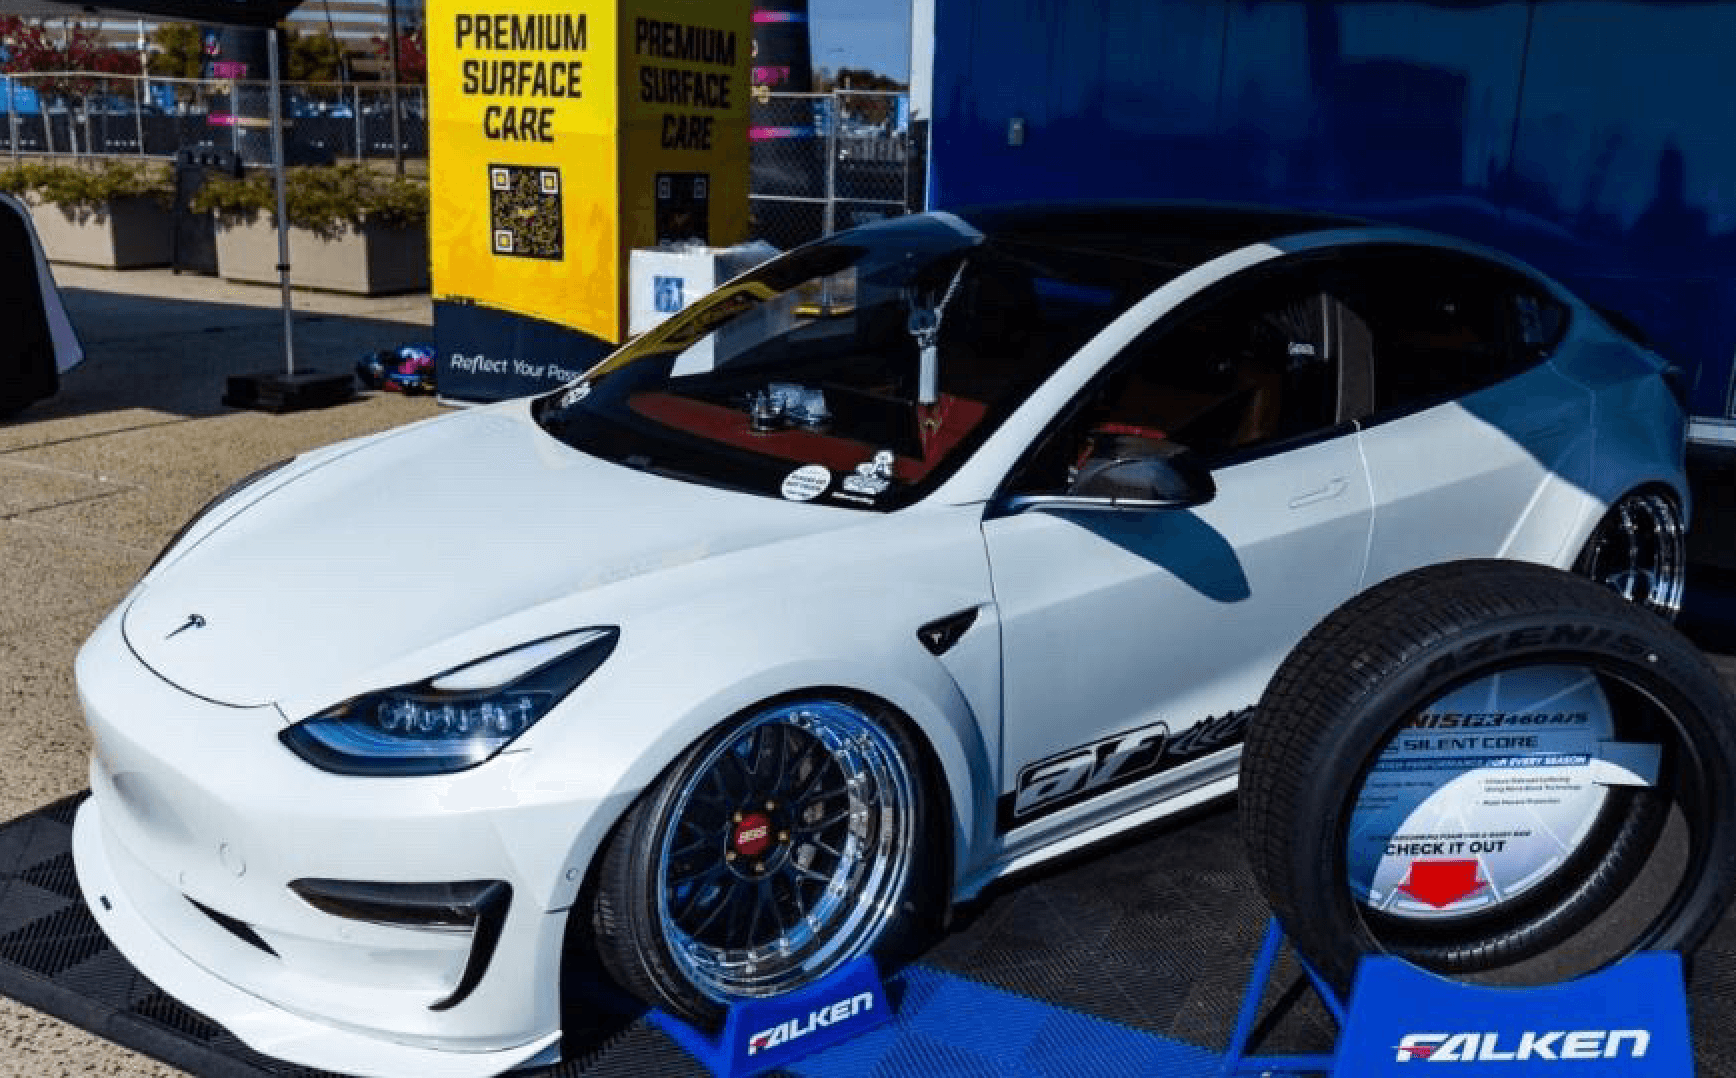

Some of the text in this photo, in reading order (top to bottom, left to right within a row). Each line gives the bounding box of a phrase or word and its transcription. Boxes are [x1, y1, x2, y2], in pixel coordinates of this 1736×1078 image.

[456, 14, 587, 51] PREMIUM
[636, 17, 736, 66] PREMIUM
[463, 60, 582, 98] SURFACE
[639, 66, 732, 109] SURFACE
[484, 106, 555, 142] CARE
[662, 114, 714, 150] CARE
[451, 353, 507, 374] Reflect
[513, 360, 544, 377] Your
[1403, 737, 1479, 750] SILENT
[1481, 735, 1538, 749] CORE
[1387, 840, 1507, 856] CHECK IT OUT
[748, 991, 874, 1057] FALKEN
[1395, 1029, 1651, 1063] FALKEN
